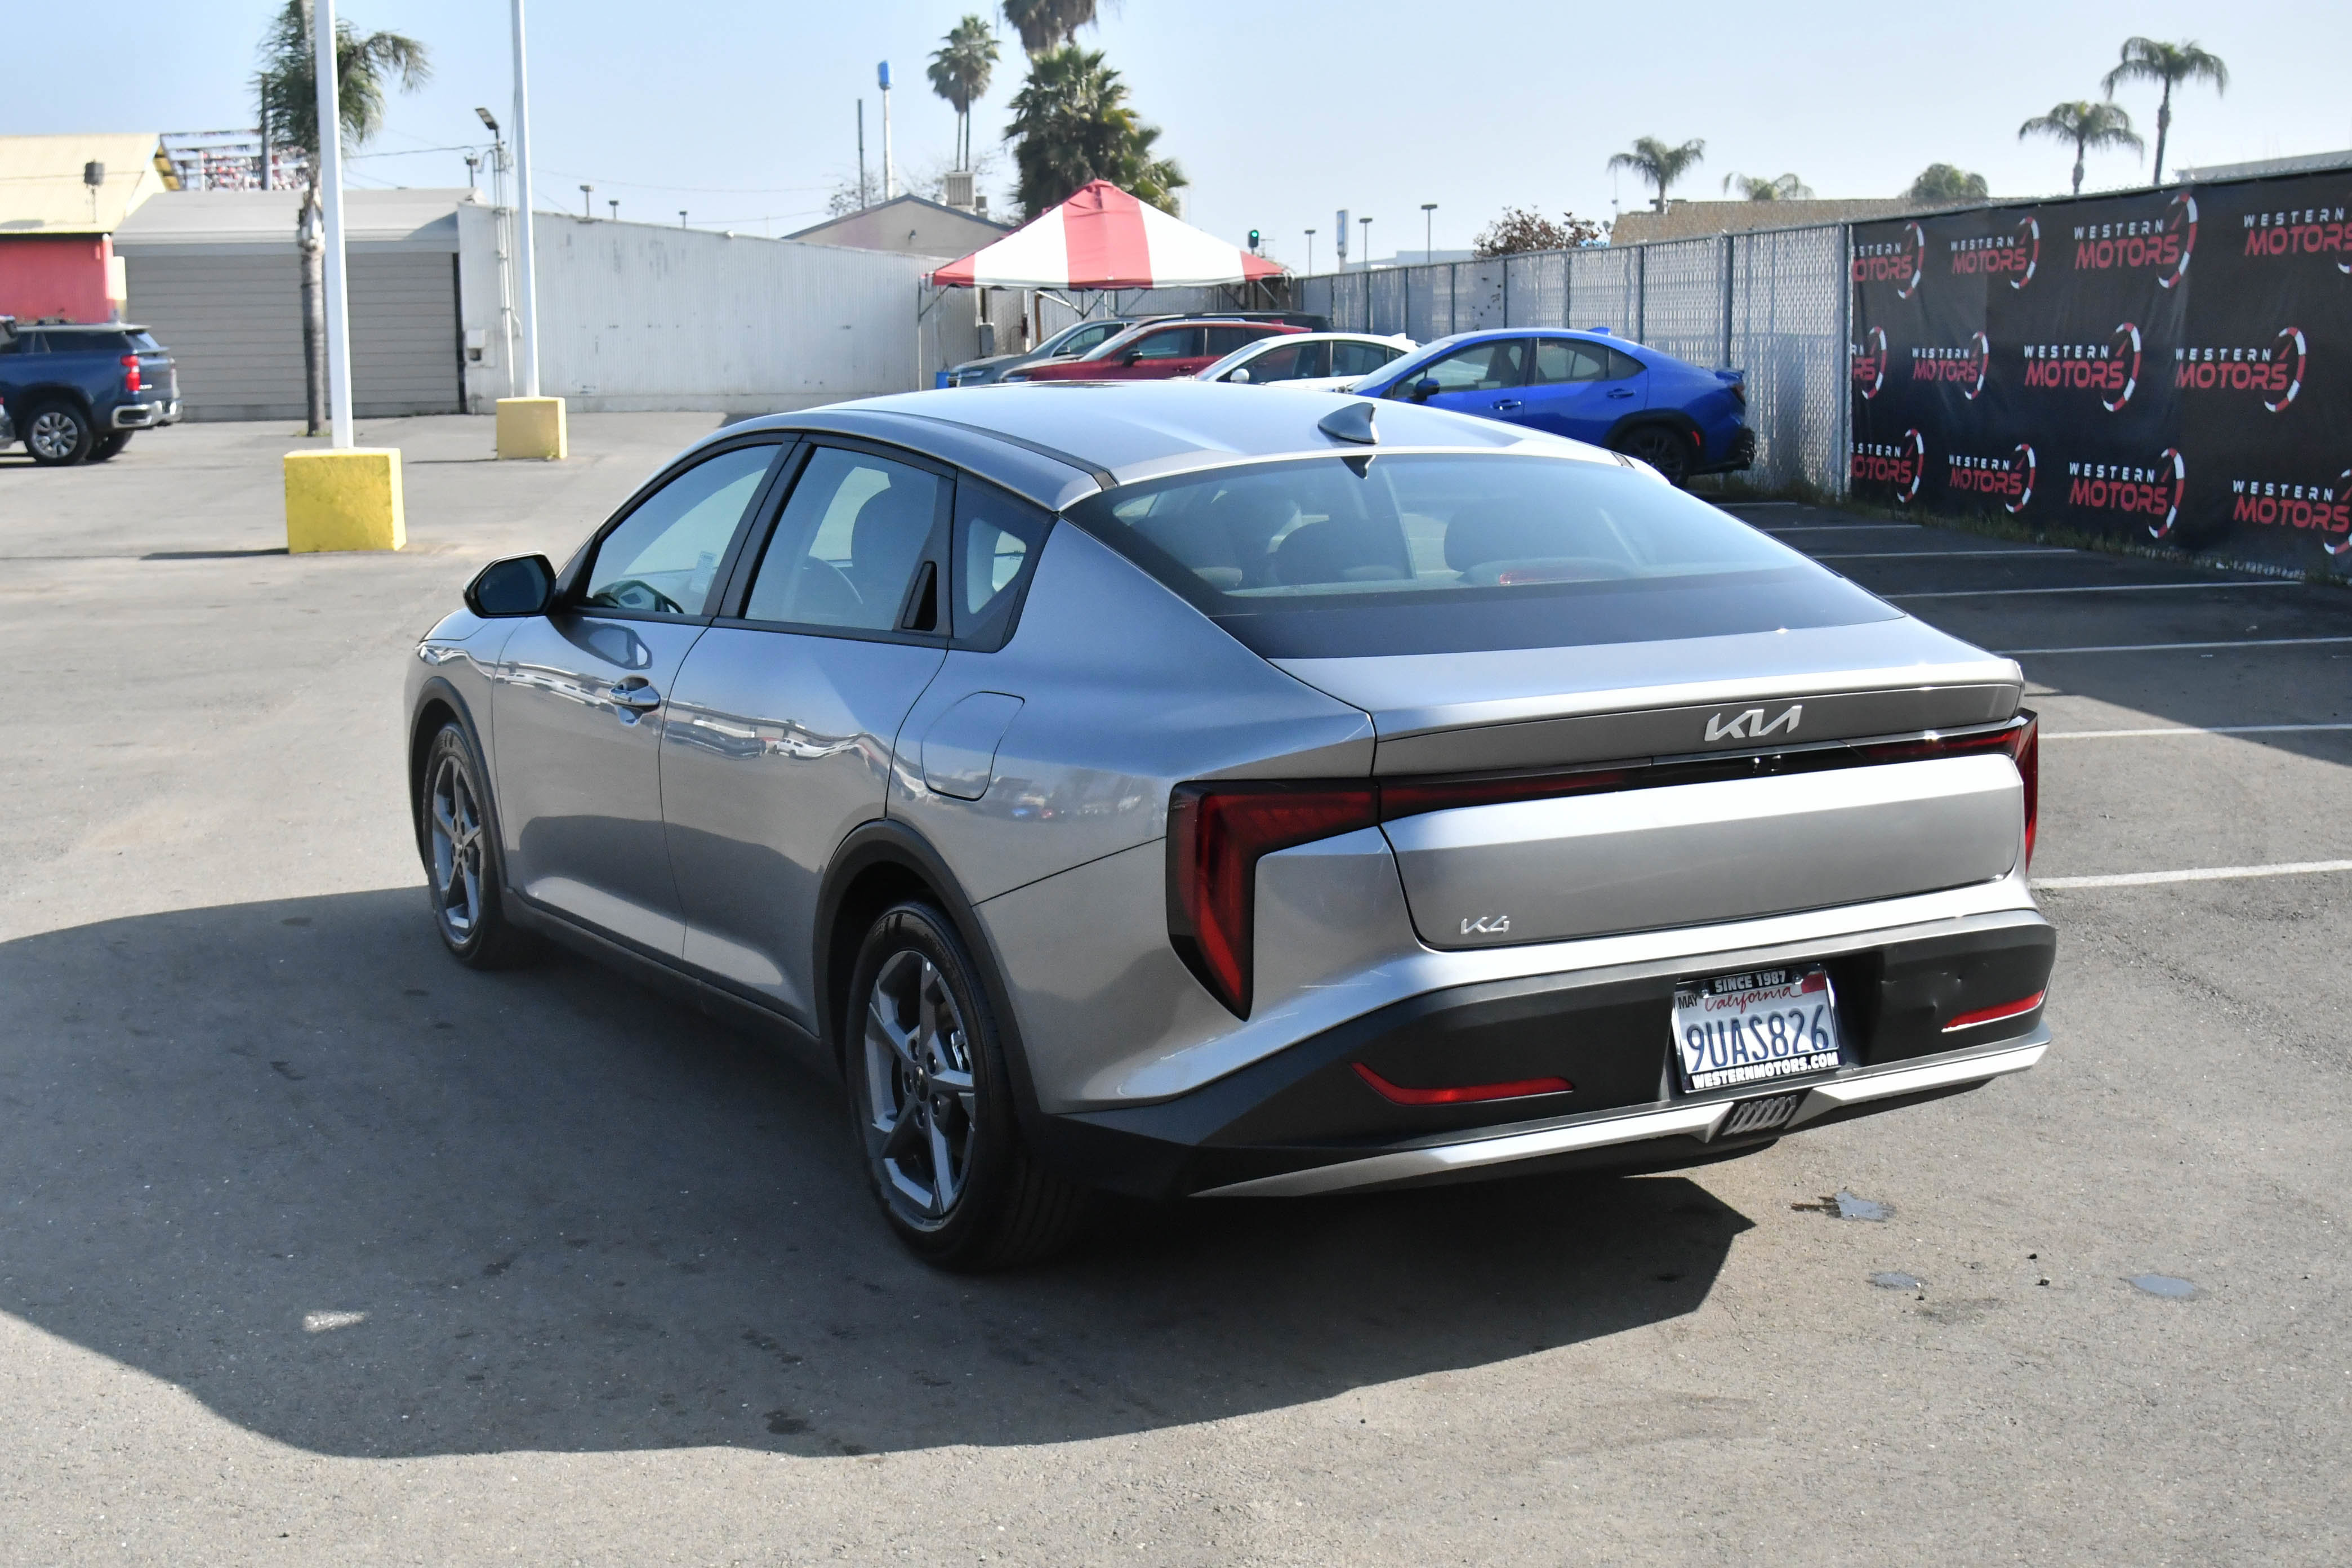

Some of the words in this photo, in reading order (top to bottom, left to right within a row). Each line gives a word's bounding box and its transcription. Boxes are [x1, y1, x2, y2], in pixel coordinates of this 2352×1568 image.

[2074, 219, 2164, 240] WESTERN
[2244, 207, 2345, 228] WESTERN
[1950, 236, 2015, 252] WESTERN
[2074, 234, 2180, 270] MOTORS
[1852, 255, 1913, 282] OTORS
[1952, 247, 2028, 274] MOTORS
[1912, 347, 1970, 359] WESTERN
[2024, 344, 2109, 359] WESTERN
[2175, 348, 2271, 362] WESTERN
[1913, 359, 1979, 382] MOTORS
[2024, 359, 2125, 389] MOTORS
[2175, 362, 2289, 390] MOTORS
[1851, 455, 1913, 484] OTORS
[1949, 454, 2010, 471] WESTERN
[2069, 461, 2155, 483] WESTERN
[1949, 467, 2023, 495] MOTORS
[2233, 479, 2333, 502] WESTERN
[2069, 477, 2168, 515] MOTORS
[2233, 495, 2350, 532] MOTORS
[1704, 705, 1802, 741] KIA
[1460, 915, 1510, 934] K4
[1715, 973, 1753, 993] SINCE
[1756, 970, 1786, 986] 1987
[1677, 995, 1698, 1010] MAY
[1704, 986, 1801, 1014] California
[1686, 1004, 1829, 1072] 9UAS826
[1691, 1052, 1839, 1089] WESTERNMOTORS.COM
